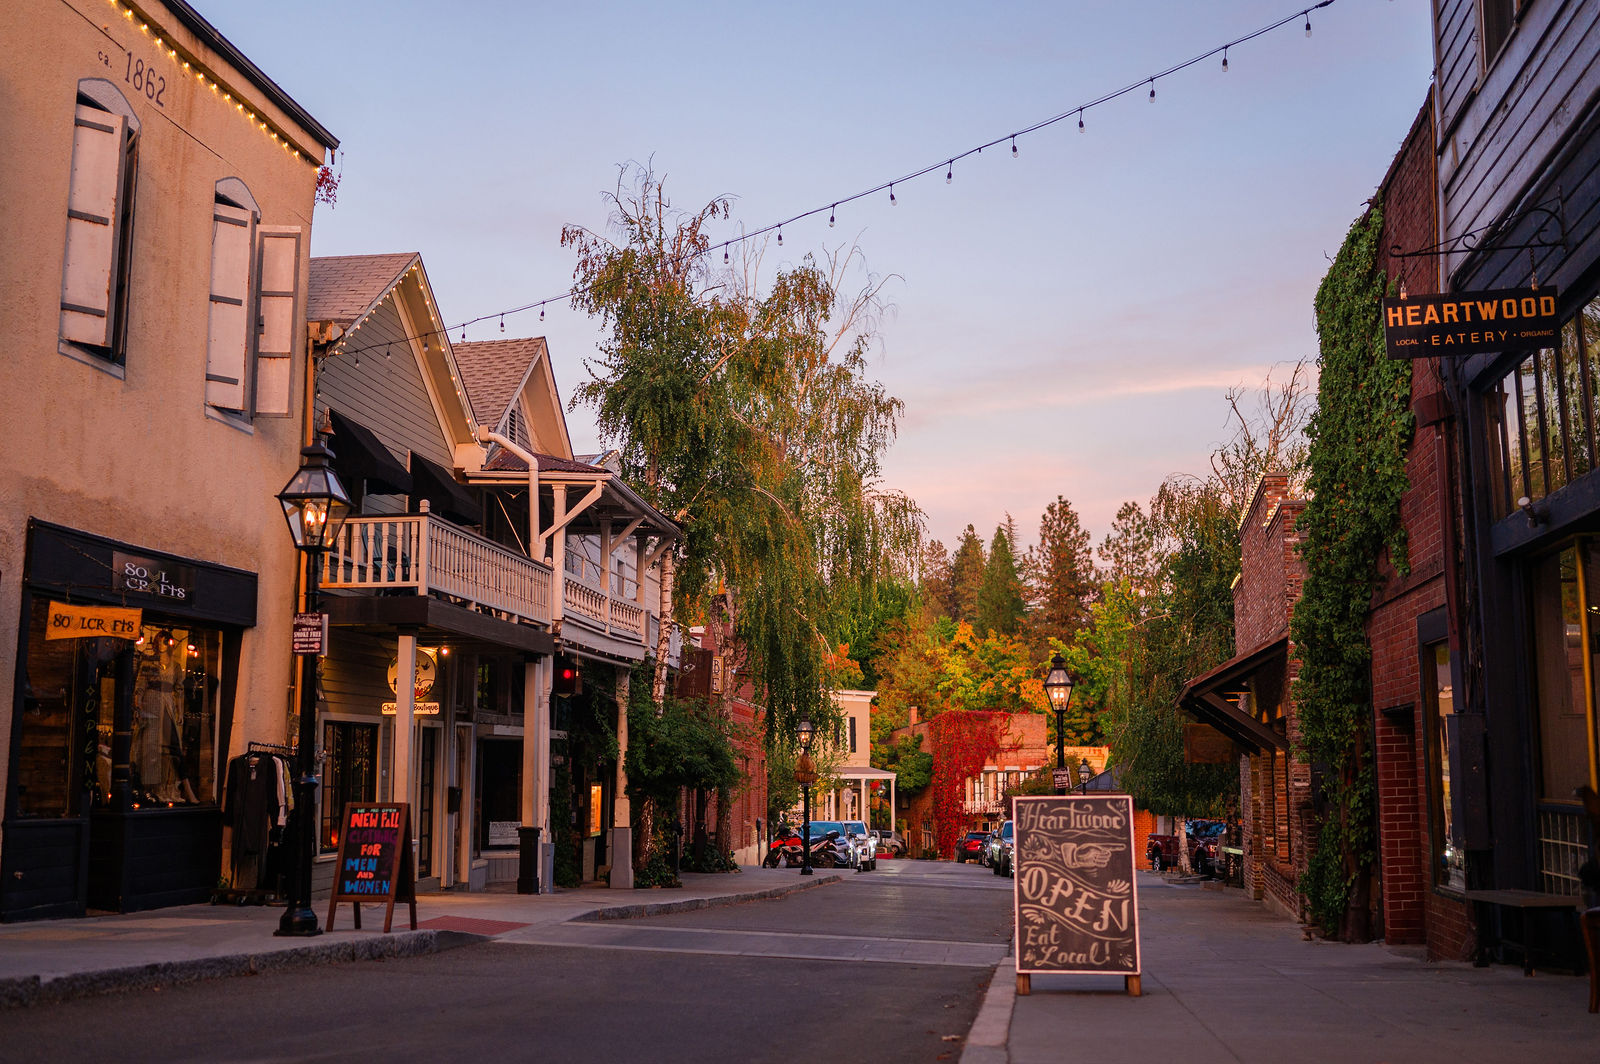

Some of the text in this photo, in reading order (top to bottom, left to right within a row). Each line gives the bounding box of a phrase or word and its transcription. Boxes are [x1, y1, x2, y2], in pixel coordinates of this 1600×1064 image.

[98, 51, 165, 107] ca. 1862
[1387, 296, 1556, 328] HEARTWOOD
[1431, 330, 1508, 346] EATERY
[1520, 329, 1554, 338] ORGANIC
[350, 812, 400, 828] NEW FALL
[1017, 802, 1126, 831] Heartwood
[361, 843, 382, 856] FOR
[345, 858, 377, 872] MEN
[356, 871, 374, 879] AND
[344, 880, 391, 894] WOMEN
[1020, 866, 1130, 932] OPEN
[1023, 924, 1060, 945] Eat
[1035, 941, 1110, 967] Local!
